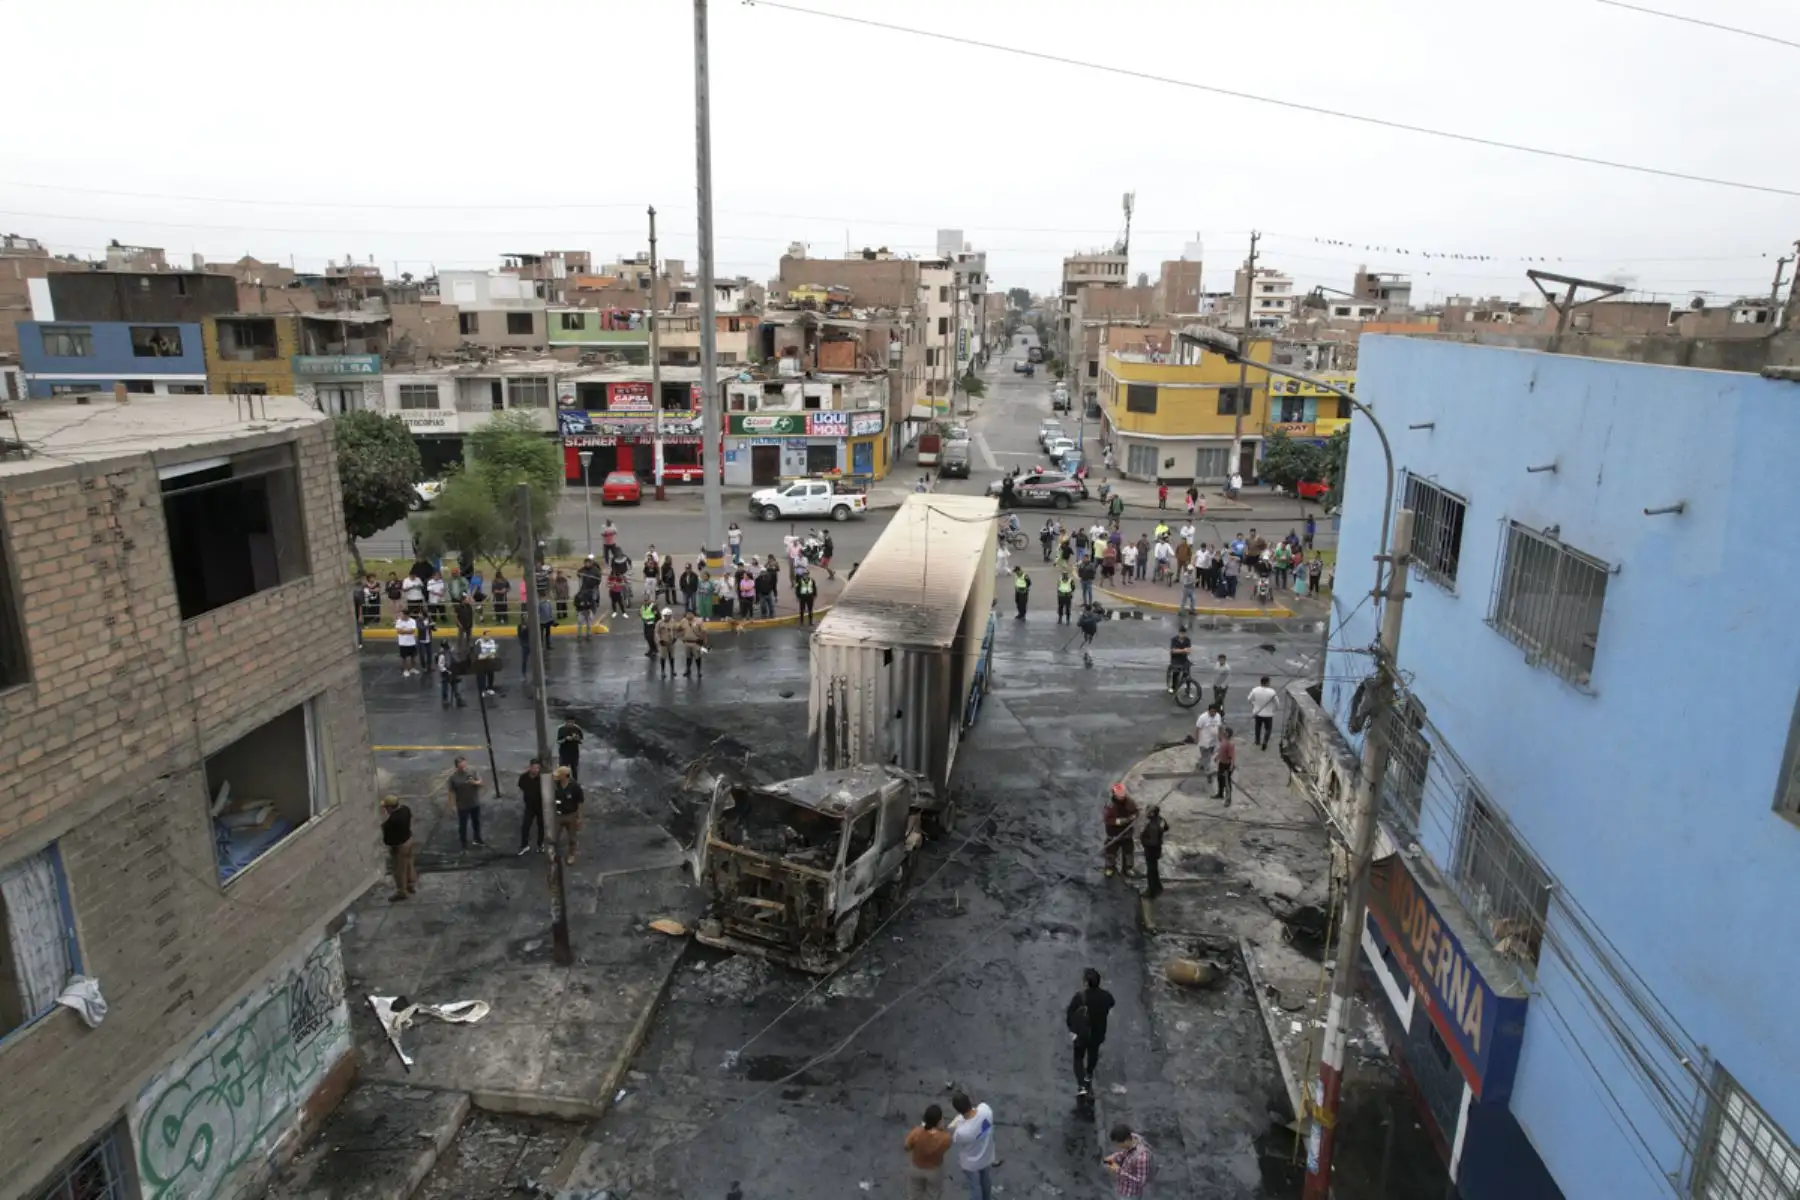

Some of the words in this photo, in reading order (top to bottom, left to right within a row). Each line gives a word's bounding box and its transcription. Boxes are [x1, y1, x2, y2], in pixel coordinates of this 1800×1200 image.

[814, 412, 847, 424] LIQUI
[814, 425, 847, 435] MOLY
[1388, 874, 1483, 1054] MODERNA
